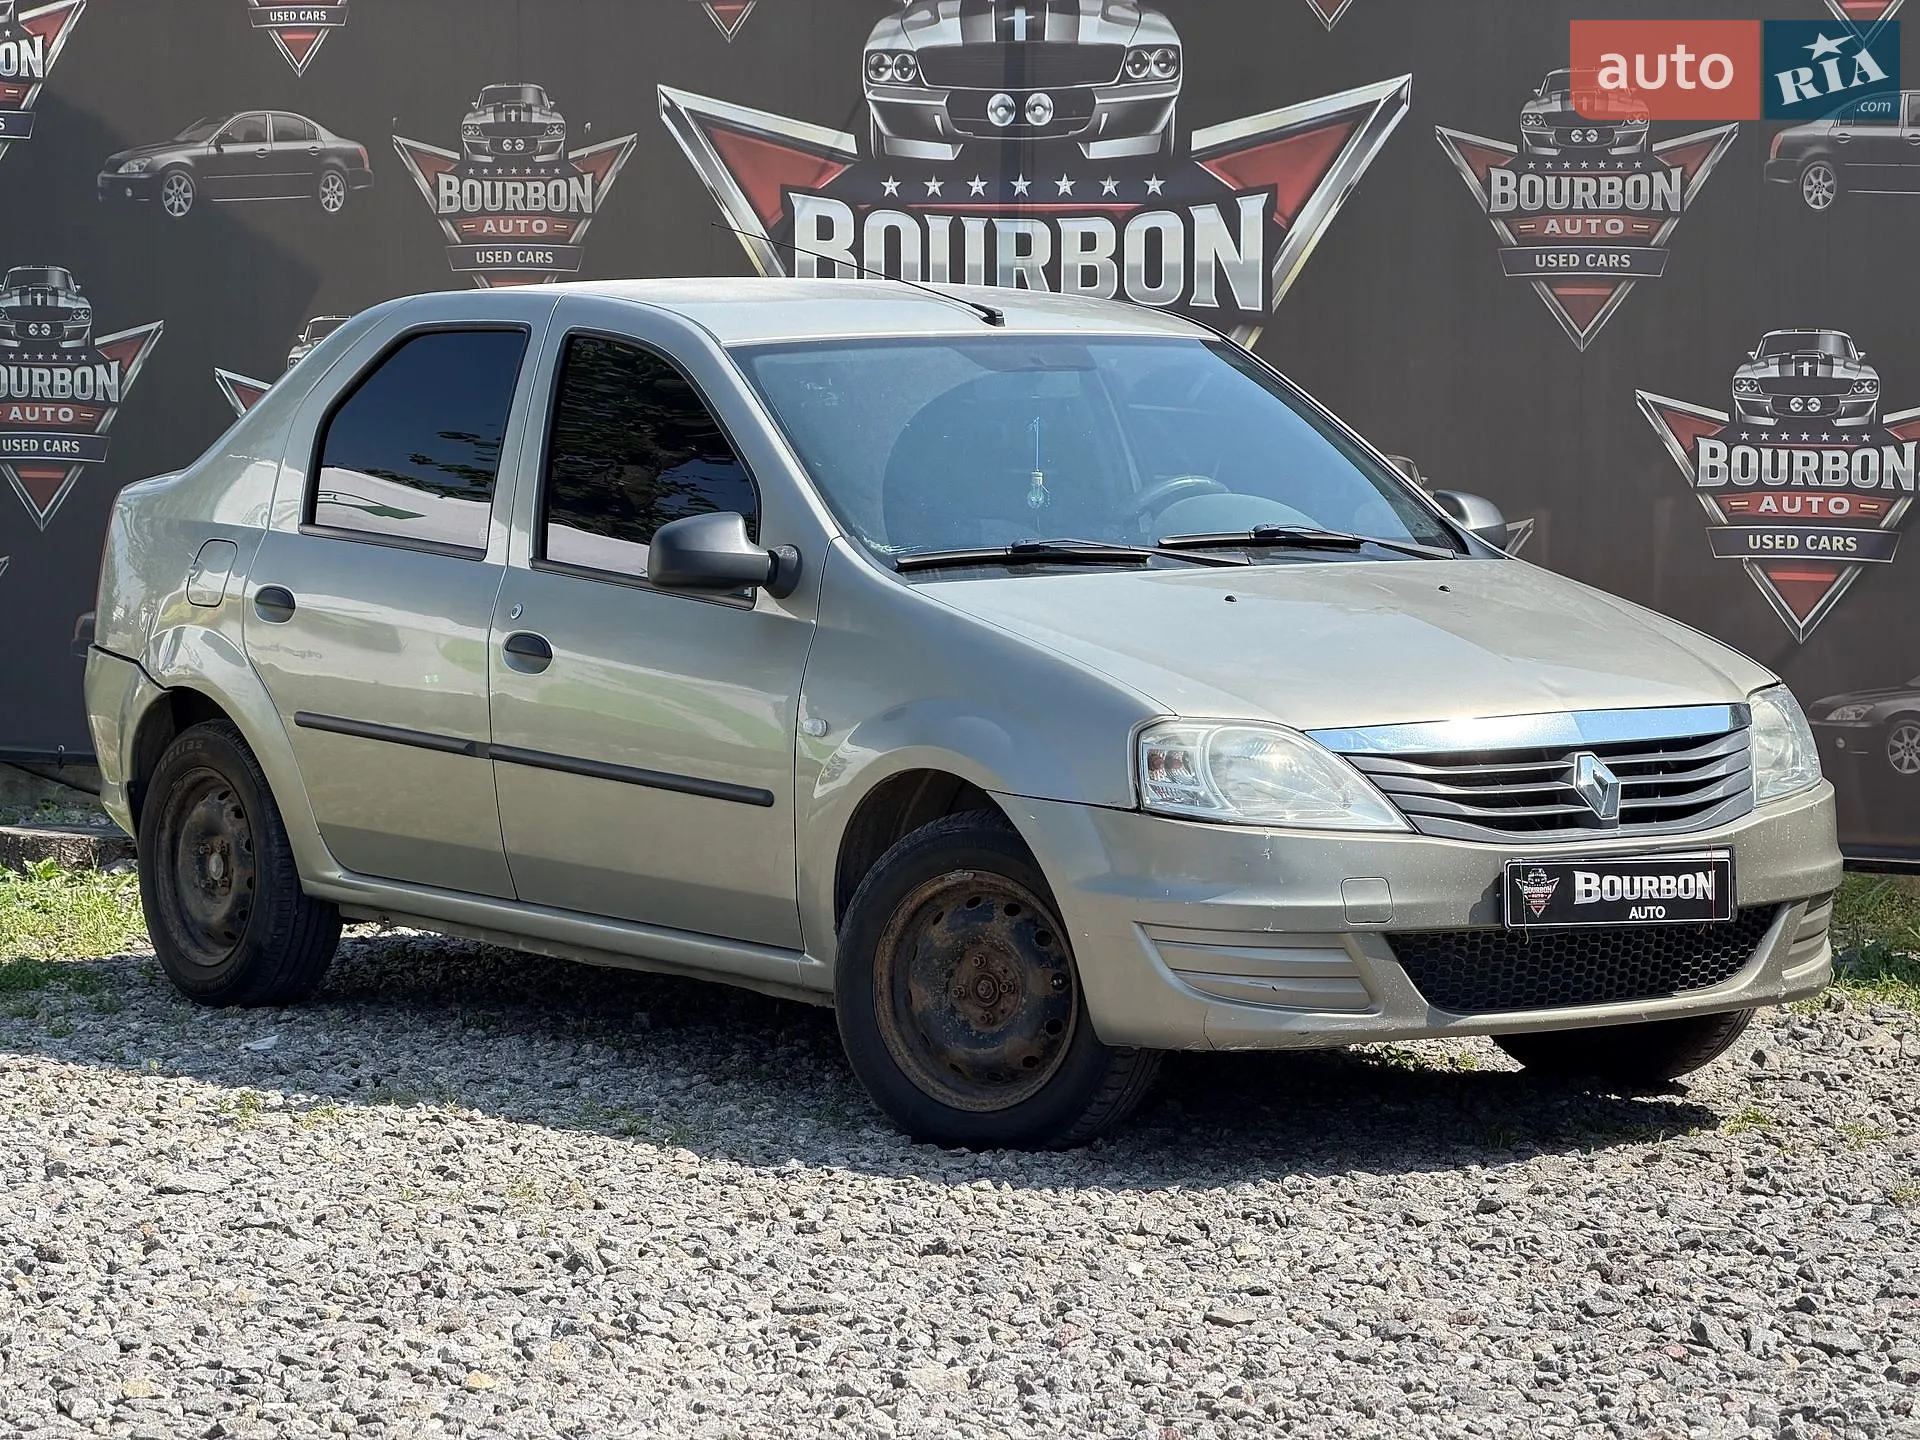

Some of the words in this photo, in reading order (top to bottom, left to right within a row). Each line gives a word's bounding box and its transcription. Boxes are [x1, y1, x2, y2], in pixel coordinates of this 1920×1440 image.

[269, 10, 298, 22] USED
[300, 9, 327, 22] CARS
[437, 172, 594, 215] BOURBON
[1489, 166, 1683, 213] BOURBON
[482, 218, 549, 236] AUTO
[1543, 217, 1626, 236] AUTO
[475, 250, 514, 266] USED
[517, 249, 555, 266] CARS
[787, 192, 1269, 312] BOURBON
[1534, 252, 1580, 268] USED
[1585, 252, 1632, 269] CARS
[8, 406, 74, 422] AUTO
[2, 439, 39, 452] USED
[43, 439, 80, 454] CARS
[1696, 436, 1918, 492] BOURBON
[1758, 495, 1851, 515] AUTO
[1747, 534, 1800, 550] USED
[1805, 534, 1858, 552] CARS
[1573, 870, 1716, 905] BOURBON
[1628, 905, 1666, 920] AUTO
